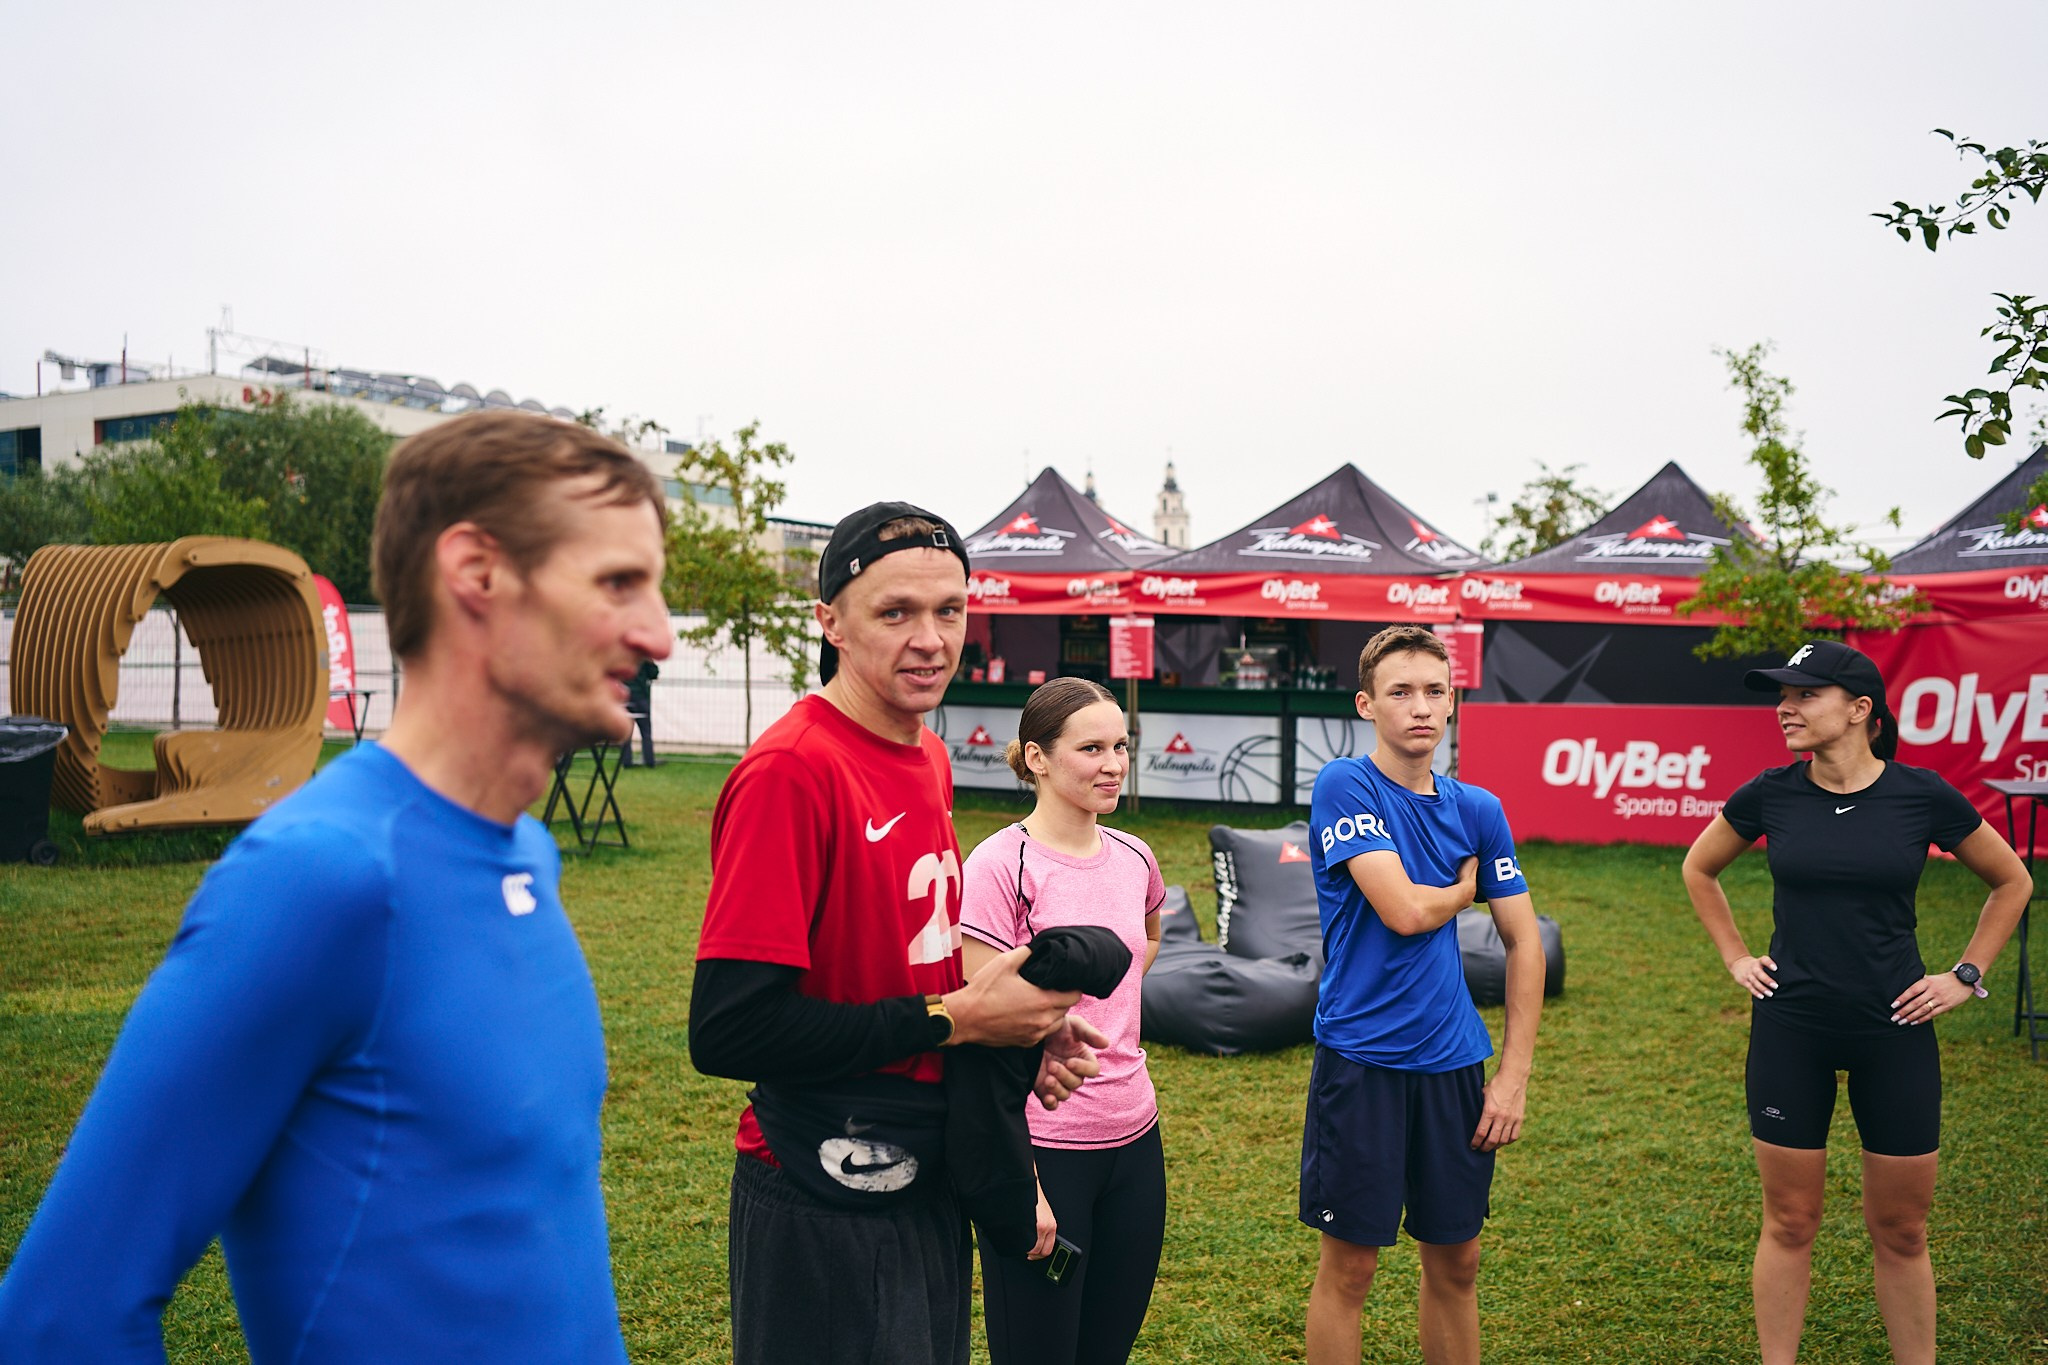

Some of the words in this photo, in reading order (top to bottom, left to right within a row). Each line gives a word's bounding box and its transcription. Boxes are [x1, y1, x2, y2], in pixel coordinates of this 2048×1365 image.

[1141, 576, 1198, 600] OlyBet
[1261, 579, 1321, 604] OlyBet
[1387, 583, 1449, 608] OlyBet
[1461, 579, 1523, 604] OlyBet
[1594, 582, 1662, 608] OlyBet
[1146, 753, 1216, 776] Kalnapilis
[1542, 738, 1711, 799] OlyBet
[1614, 793, 1677, 819] Sporto
[1680, 796, 1726, 818] Bara
